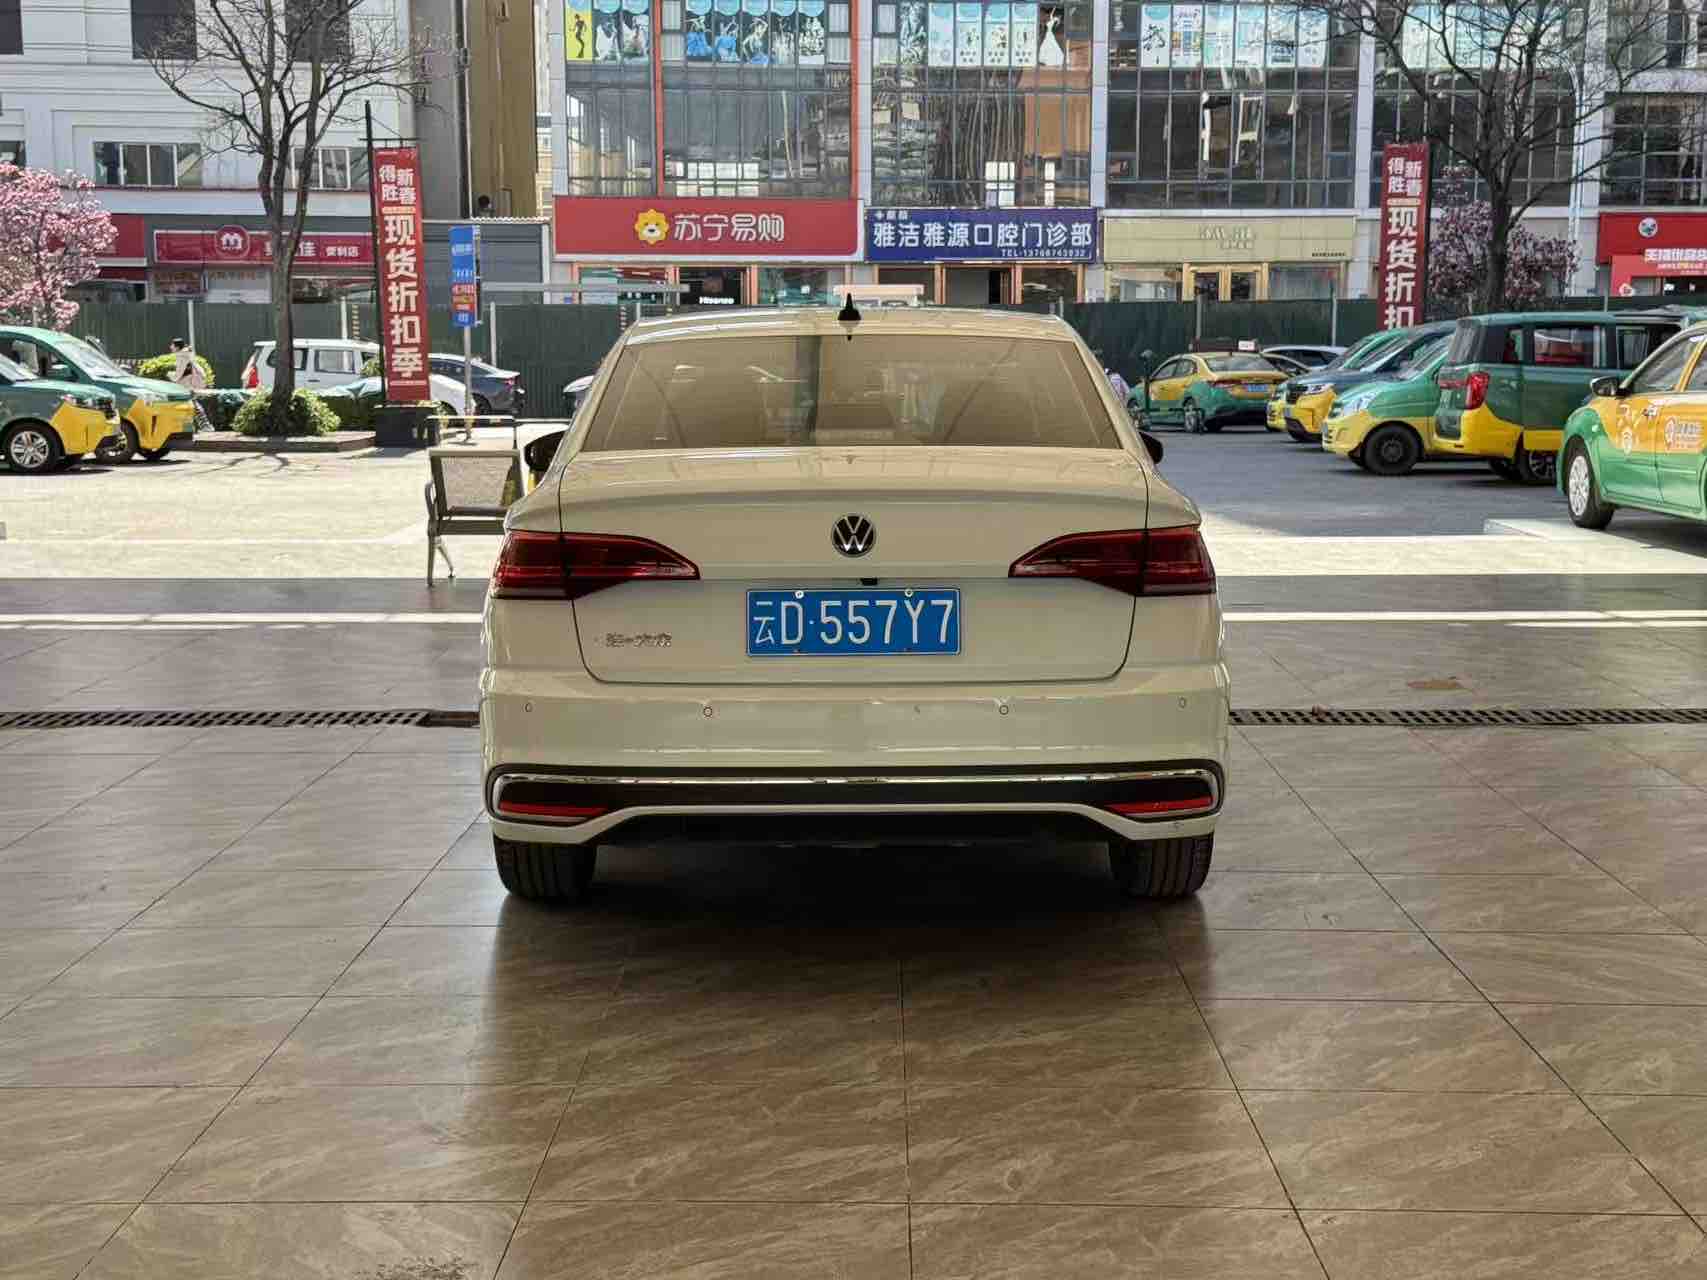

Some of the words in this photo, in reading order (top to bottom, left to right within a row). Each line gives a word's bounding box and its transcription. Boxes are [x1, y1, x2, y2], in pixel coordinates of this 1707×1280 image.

[674, 213, 785, 242] 苏宁易购
[873, 222, 1093, 248] 雅洁雅源口腔门诊部
[384, 214, 424, 378] 现货折扣季
[752, 600, 955, 646] 云D·557Y7
